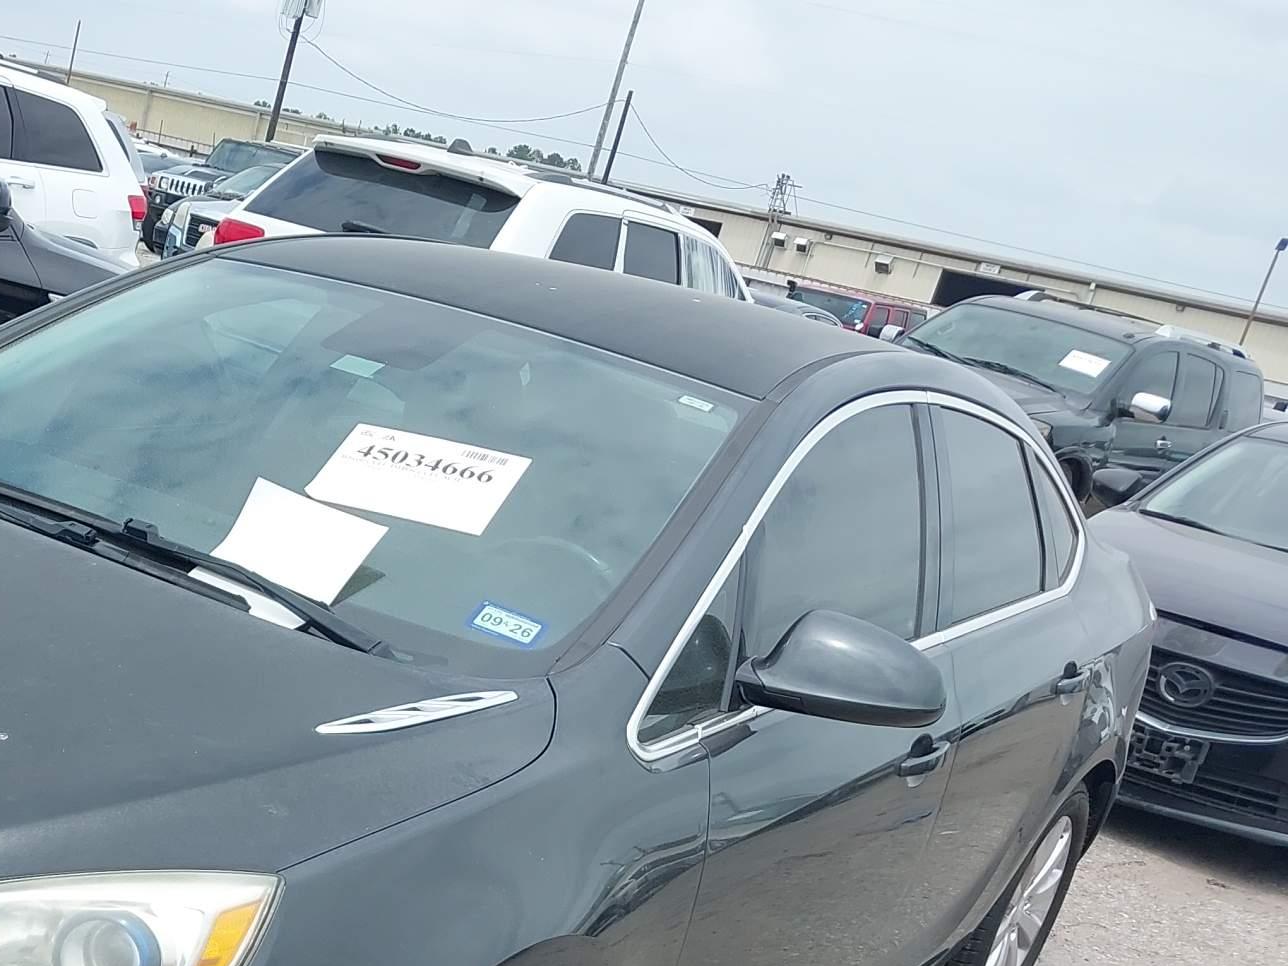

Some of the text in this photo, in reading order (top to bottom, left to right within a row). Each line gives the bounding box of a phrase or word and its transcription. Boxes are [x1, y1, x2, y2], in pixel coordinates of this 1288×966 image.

[357, 444, 495, 483] 45034666
[480, 612, 503, 627] 09
[509, 623, 534, 638] 26
